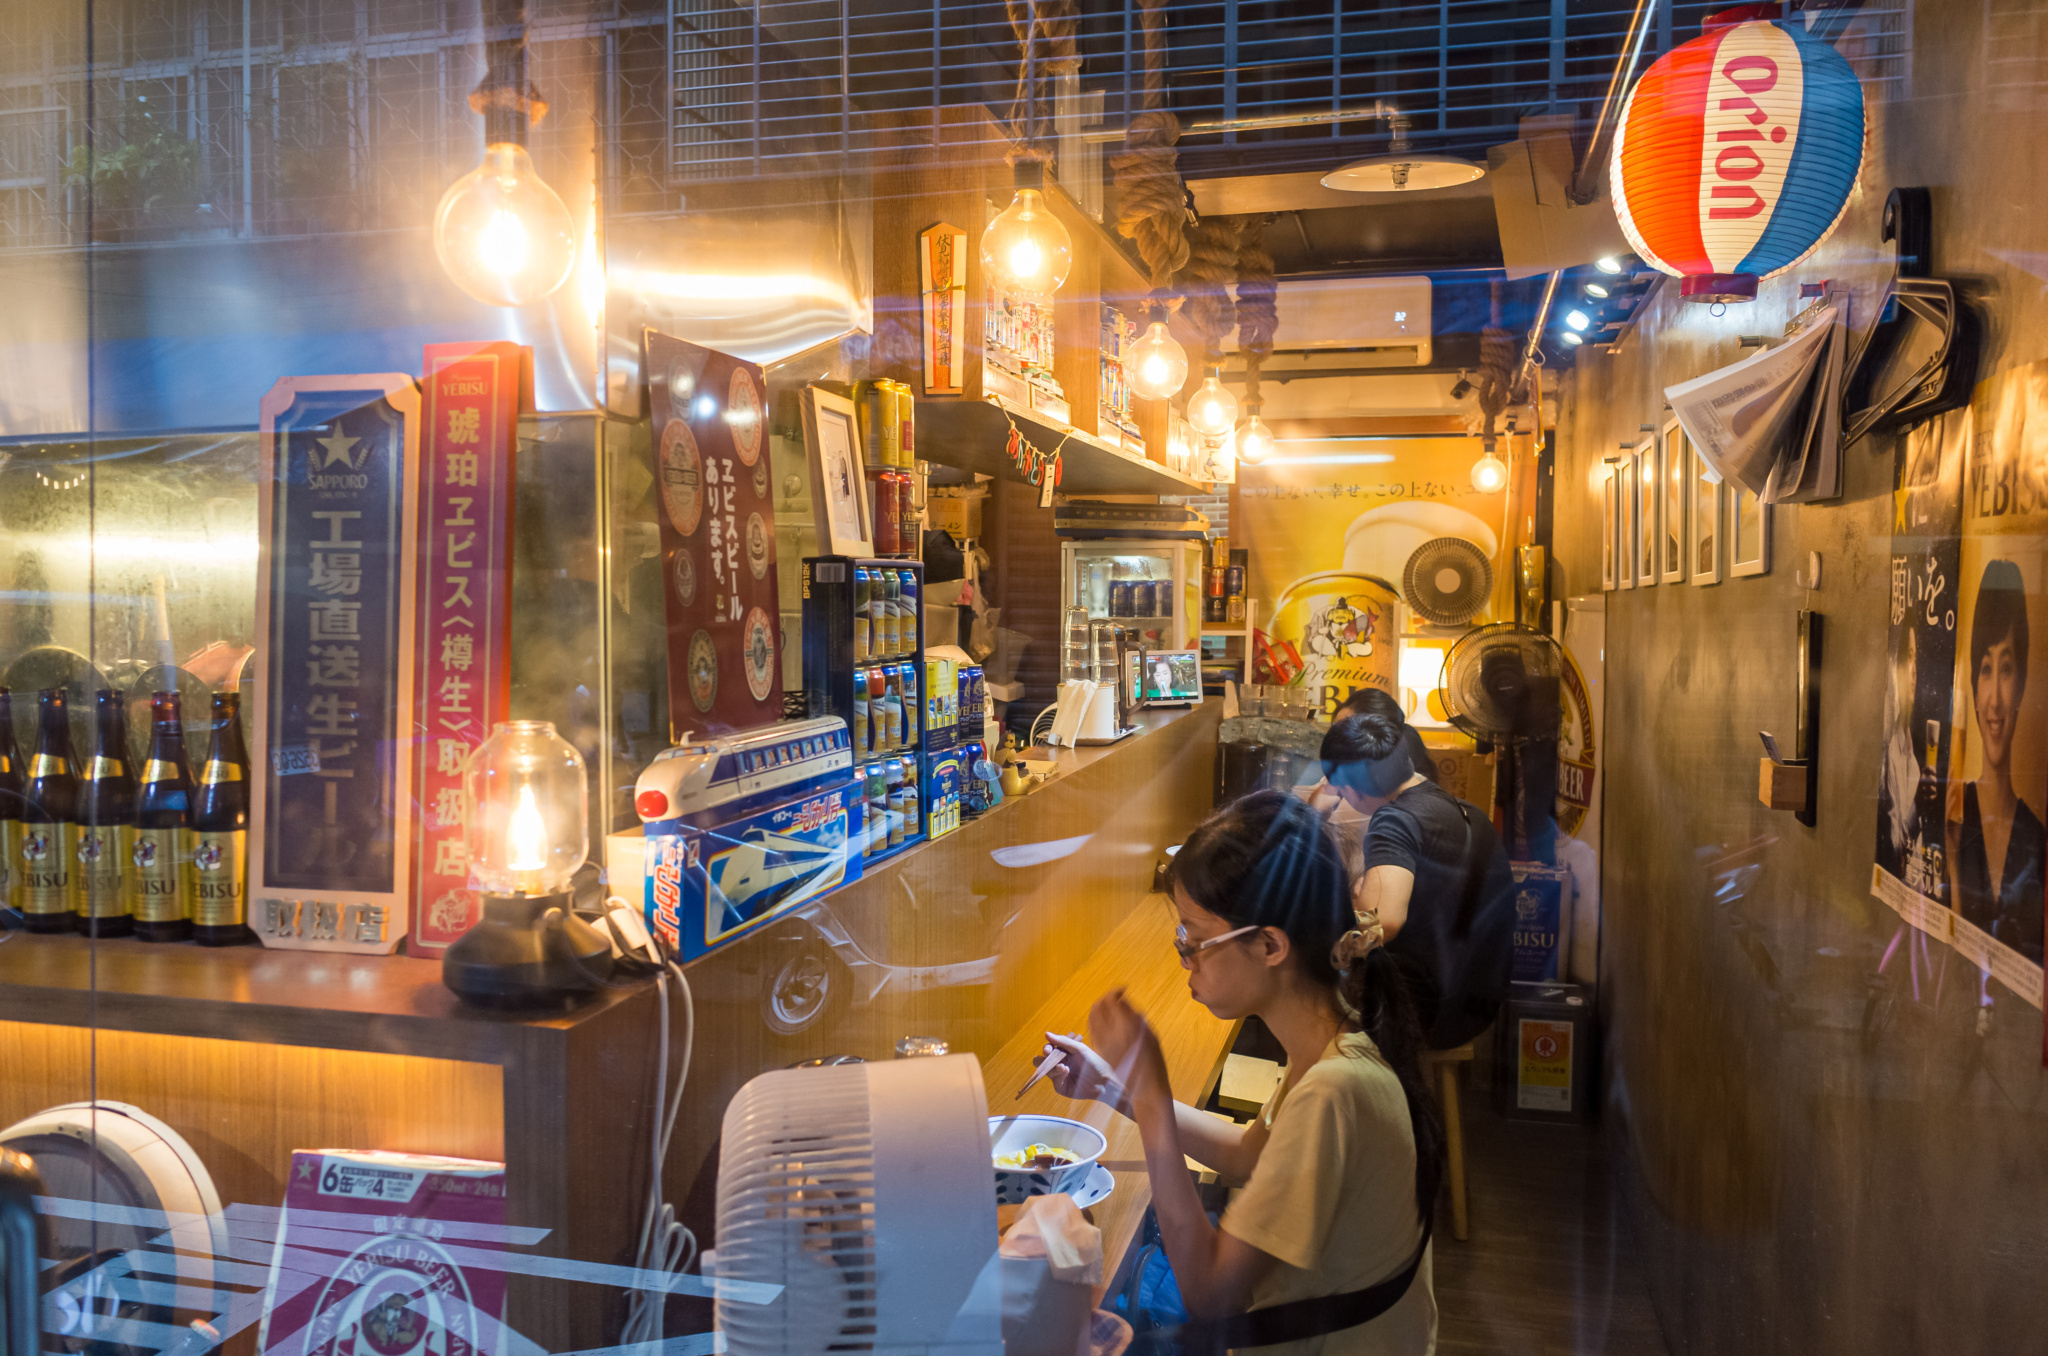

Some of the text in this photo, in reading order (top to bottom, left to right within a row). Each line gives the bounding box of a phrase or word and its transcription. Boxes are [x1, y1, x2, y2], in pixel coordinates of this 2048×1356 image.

[1709, 55, 1788, 220] Orion
[441, 381, 489, 397] YEBISU
[308, 473, 368, 490] SAPPORO
[705, 455, 726, 586] あります。
[1291, 660, 1390, 686] Premium
[1558, 761, 1585, 802] BEER
[1513, 931, 1555, 949] BISU
[343, 1243, 457, 1300] YEBISU BEER
